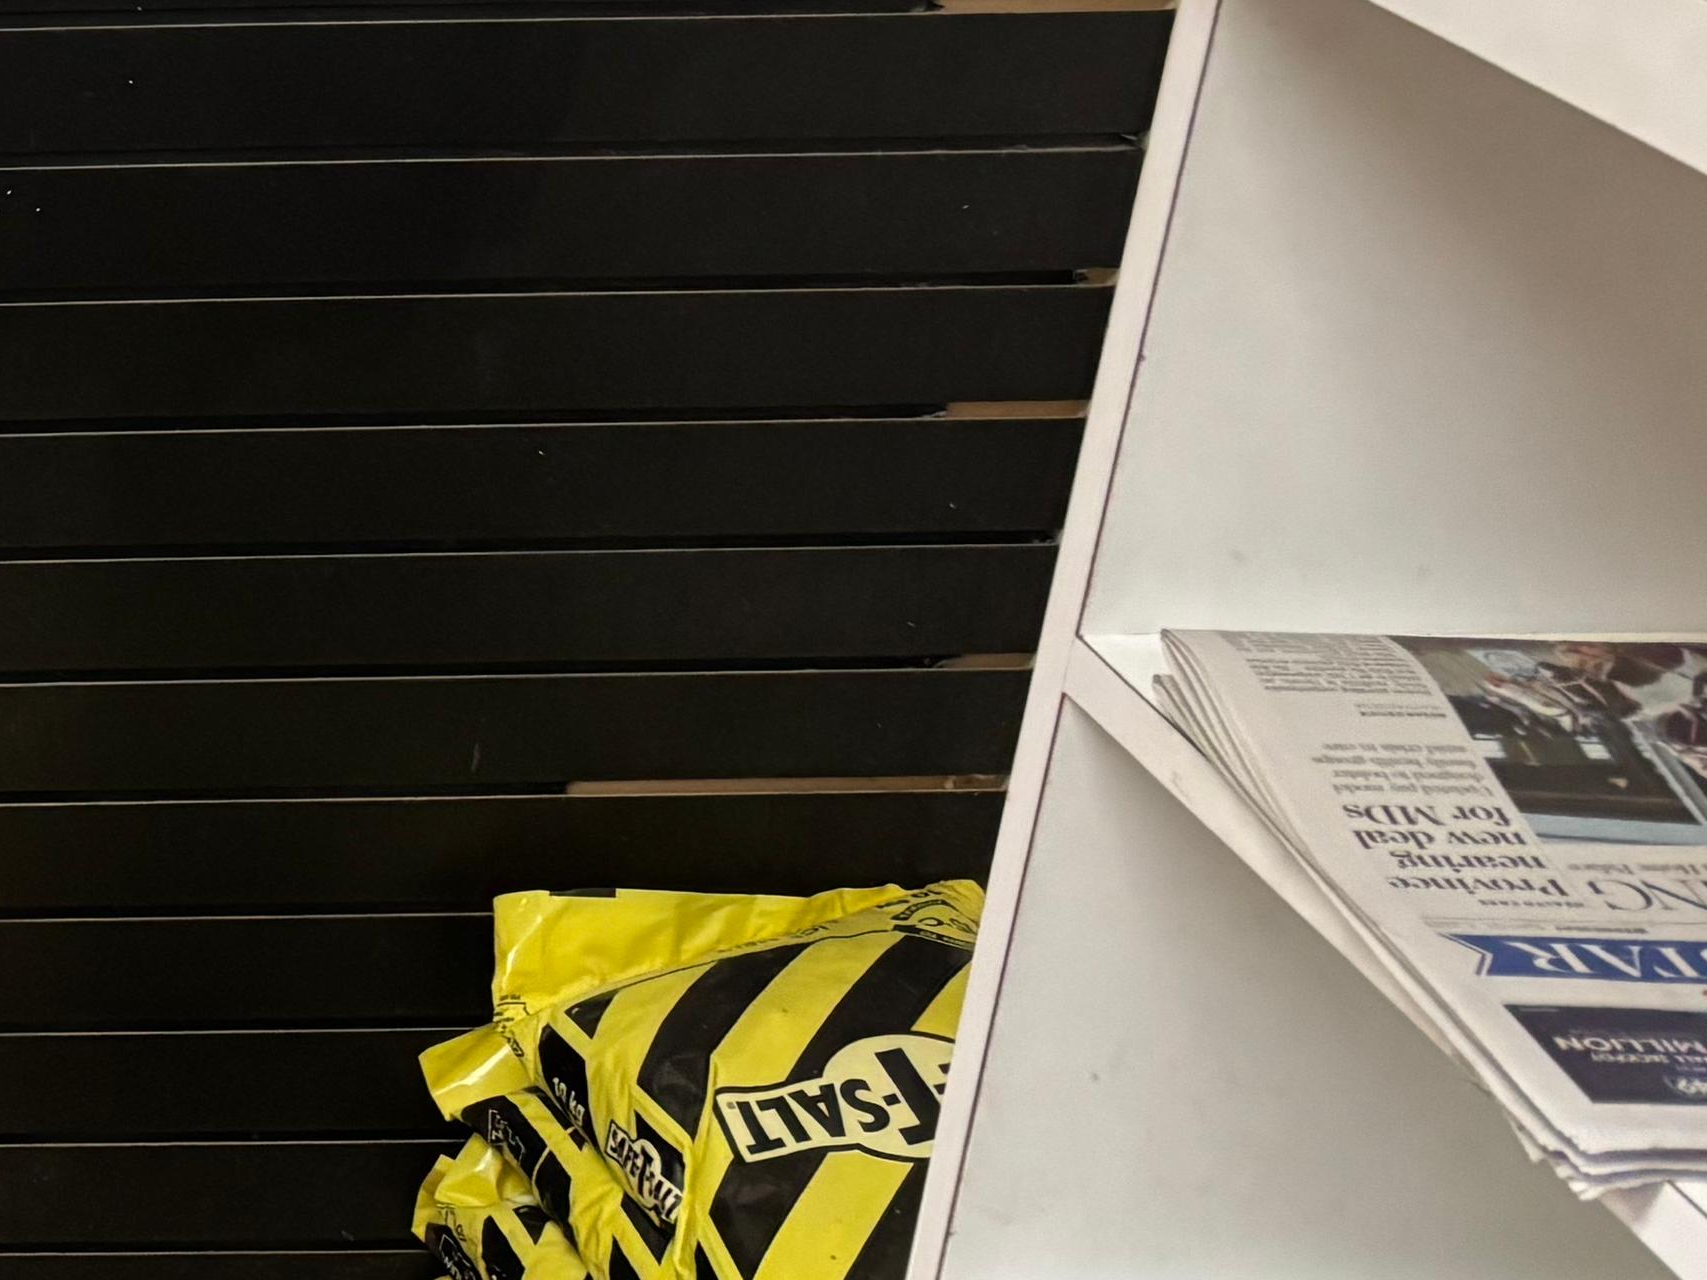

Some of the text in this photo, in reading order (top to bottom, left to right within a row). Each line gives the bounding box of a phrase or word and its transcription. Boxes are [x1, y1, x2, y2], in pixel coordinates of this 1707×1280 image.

[1342, 804, 1510, 826] for MDs
[1352, 829, 1524, 850] new deal
[1391, 850, 1546, 872] nearing
[1386, 876, 1568, 896] Province
